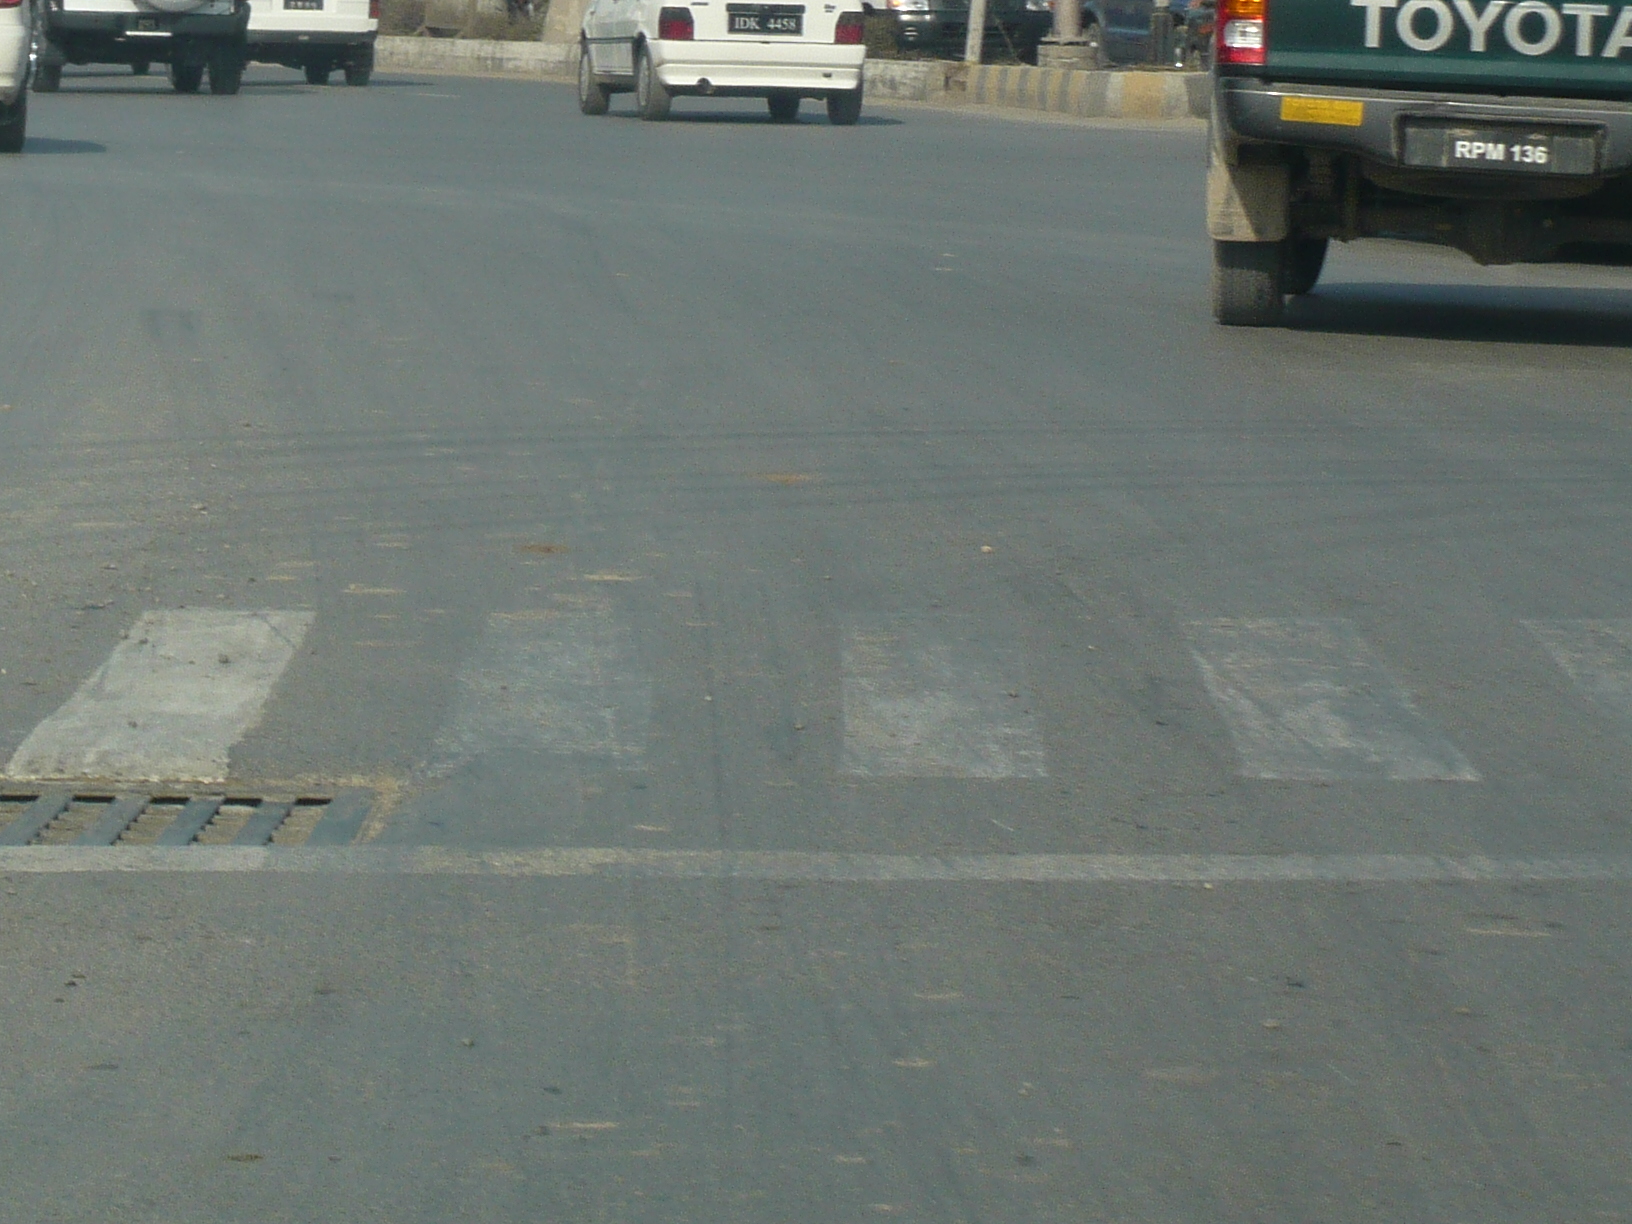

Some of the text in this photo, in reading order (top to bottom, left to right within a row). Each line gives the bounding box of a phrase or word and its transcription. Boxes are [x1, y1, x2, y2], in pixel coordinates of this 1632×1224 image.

[735, 17, 797, 30] IDK 4458
[1455, 140, 1549, 164] RPM 136
